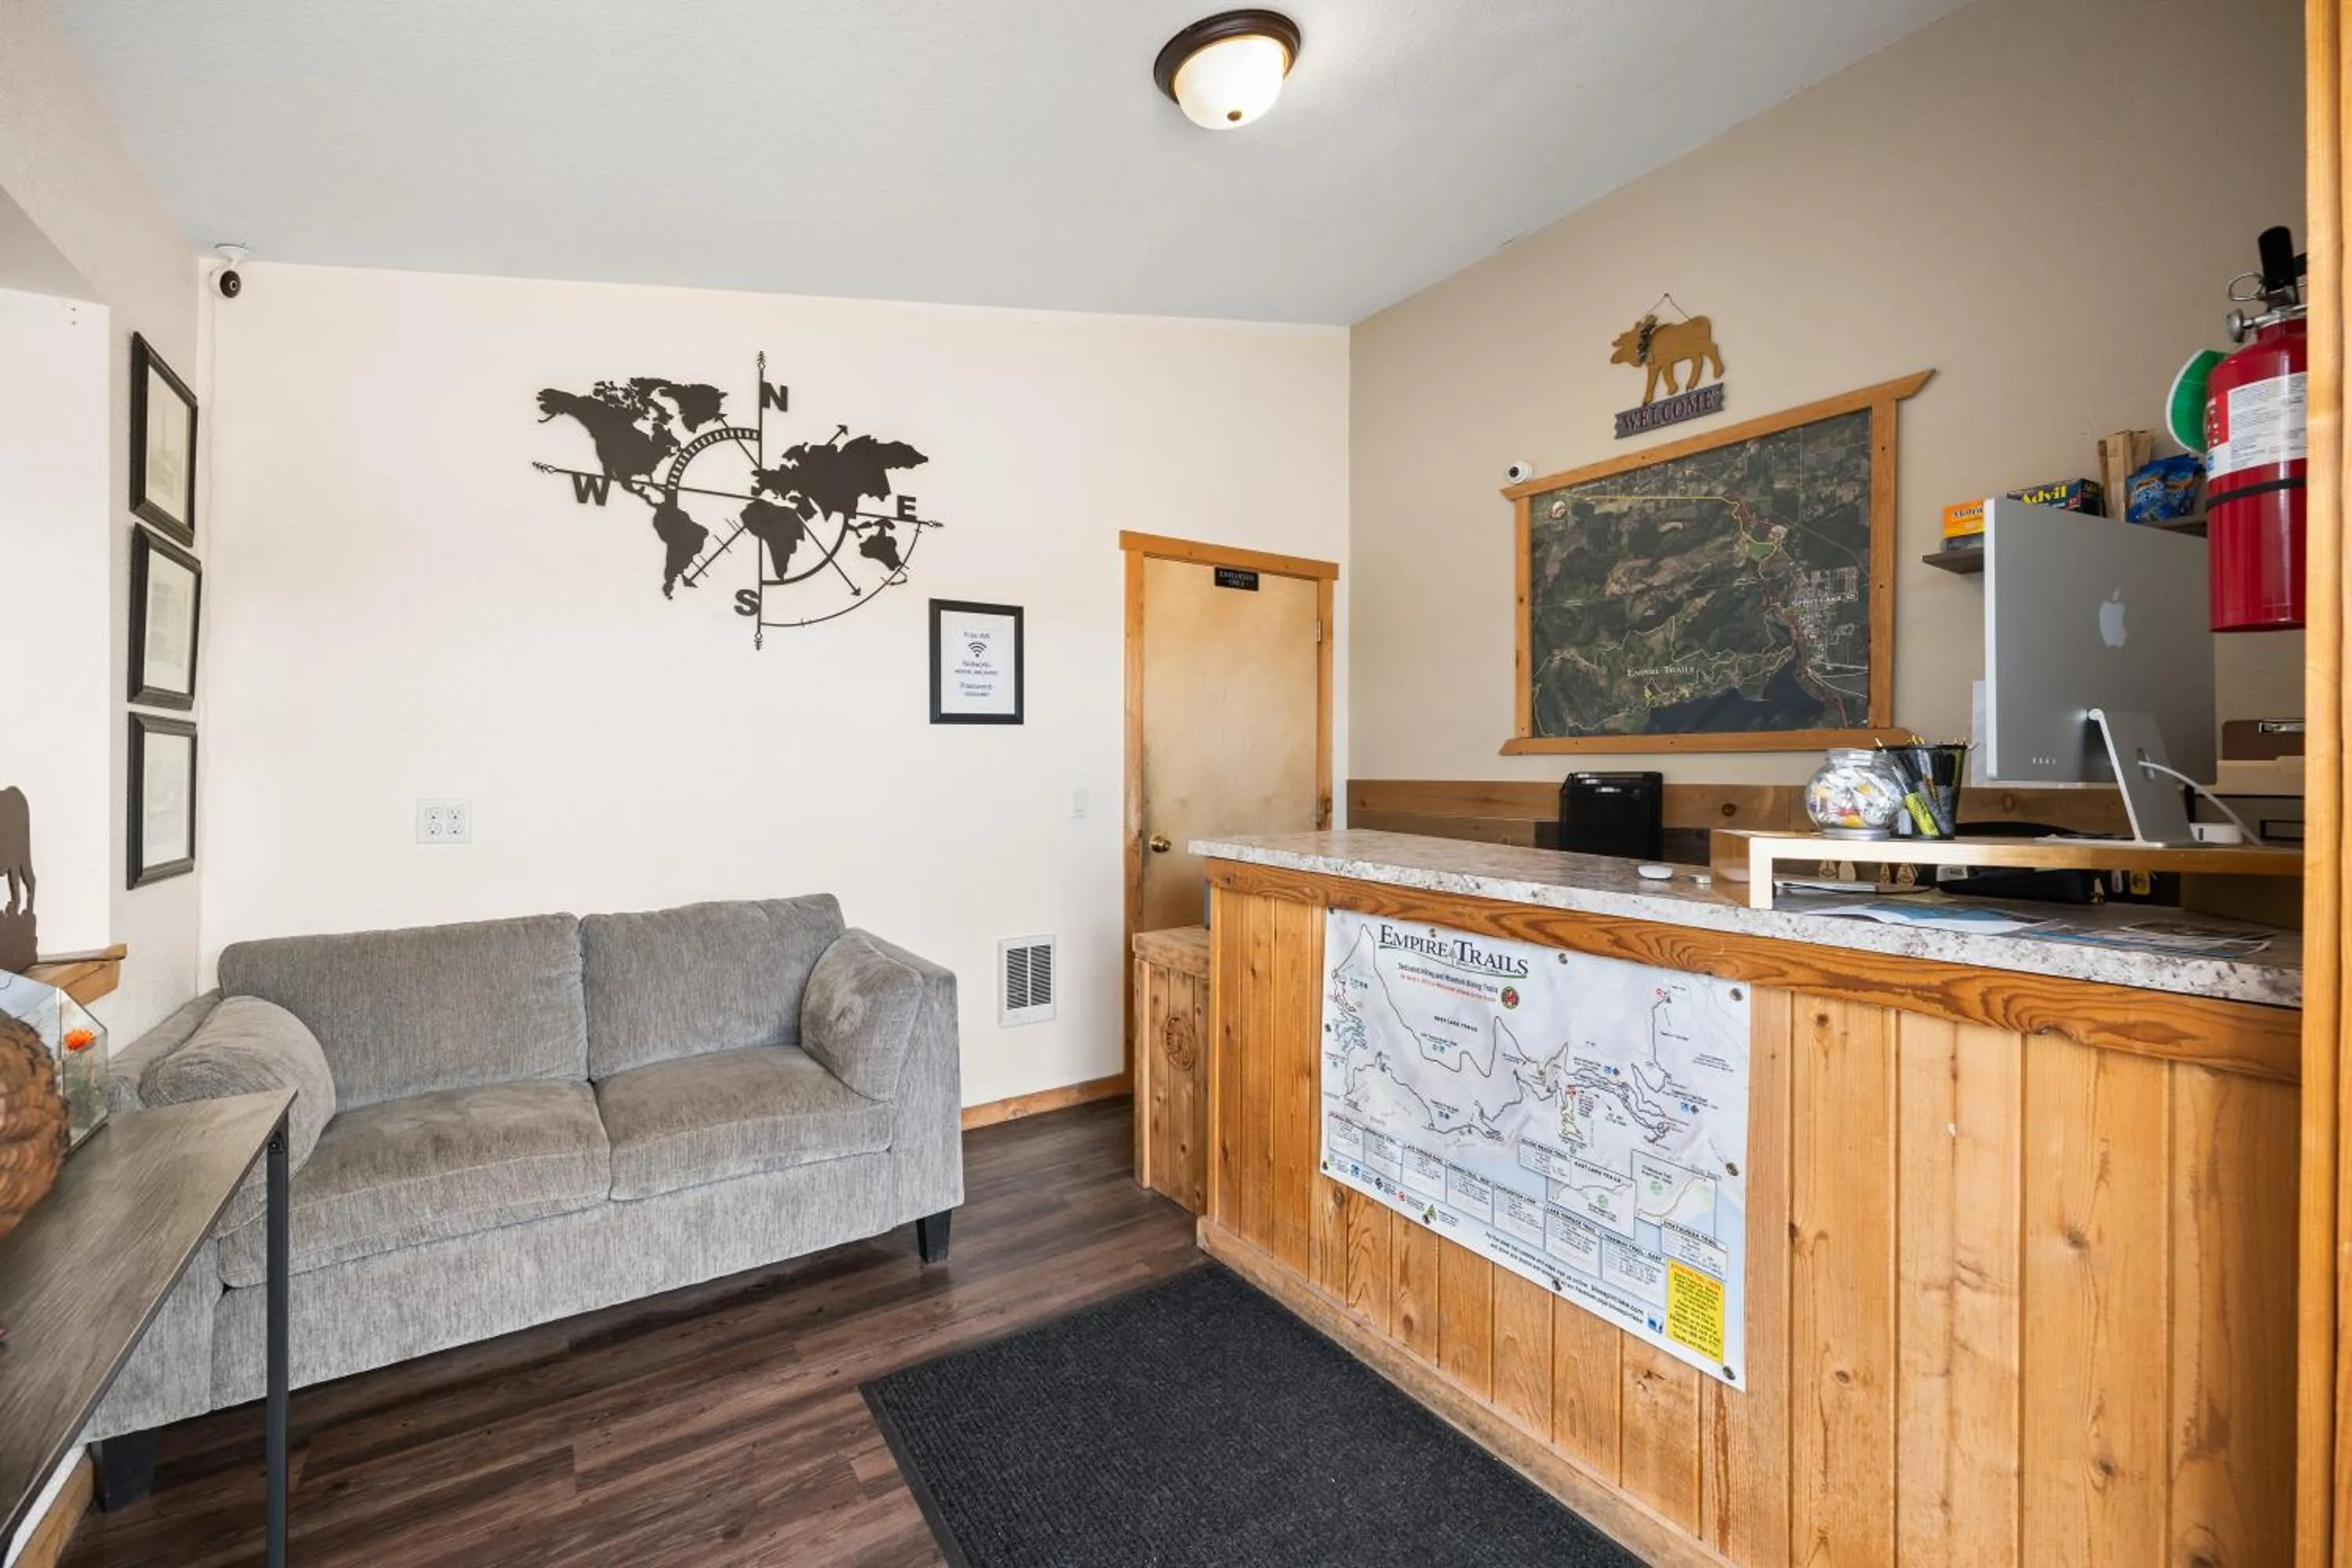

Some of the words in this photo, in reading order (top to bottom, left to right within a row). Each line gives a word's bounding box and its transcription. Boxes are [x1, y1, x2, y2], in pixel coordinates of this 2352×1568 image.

[761, 382, 789, 412] N
[1624, 390, 1714, 430] WELCOME
[571, 474, 612, 506] W
[2022, 485, 2067, 503] Advil
[897, 495, 916, 521] E
[734, 590, 759, 616] S
[1380, 924, 1448, 958] EMPIRE
[1454, 939, 1528, 975] TRAILS
